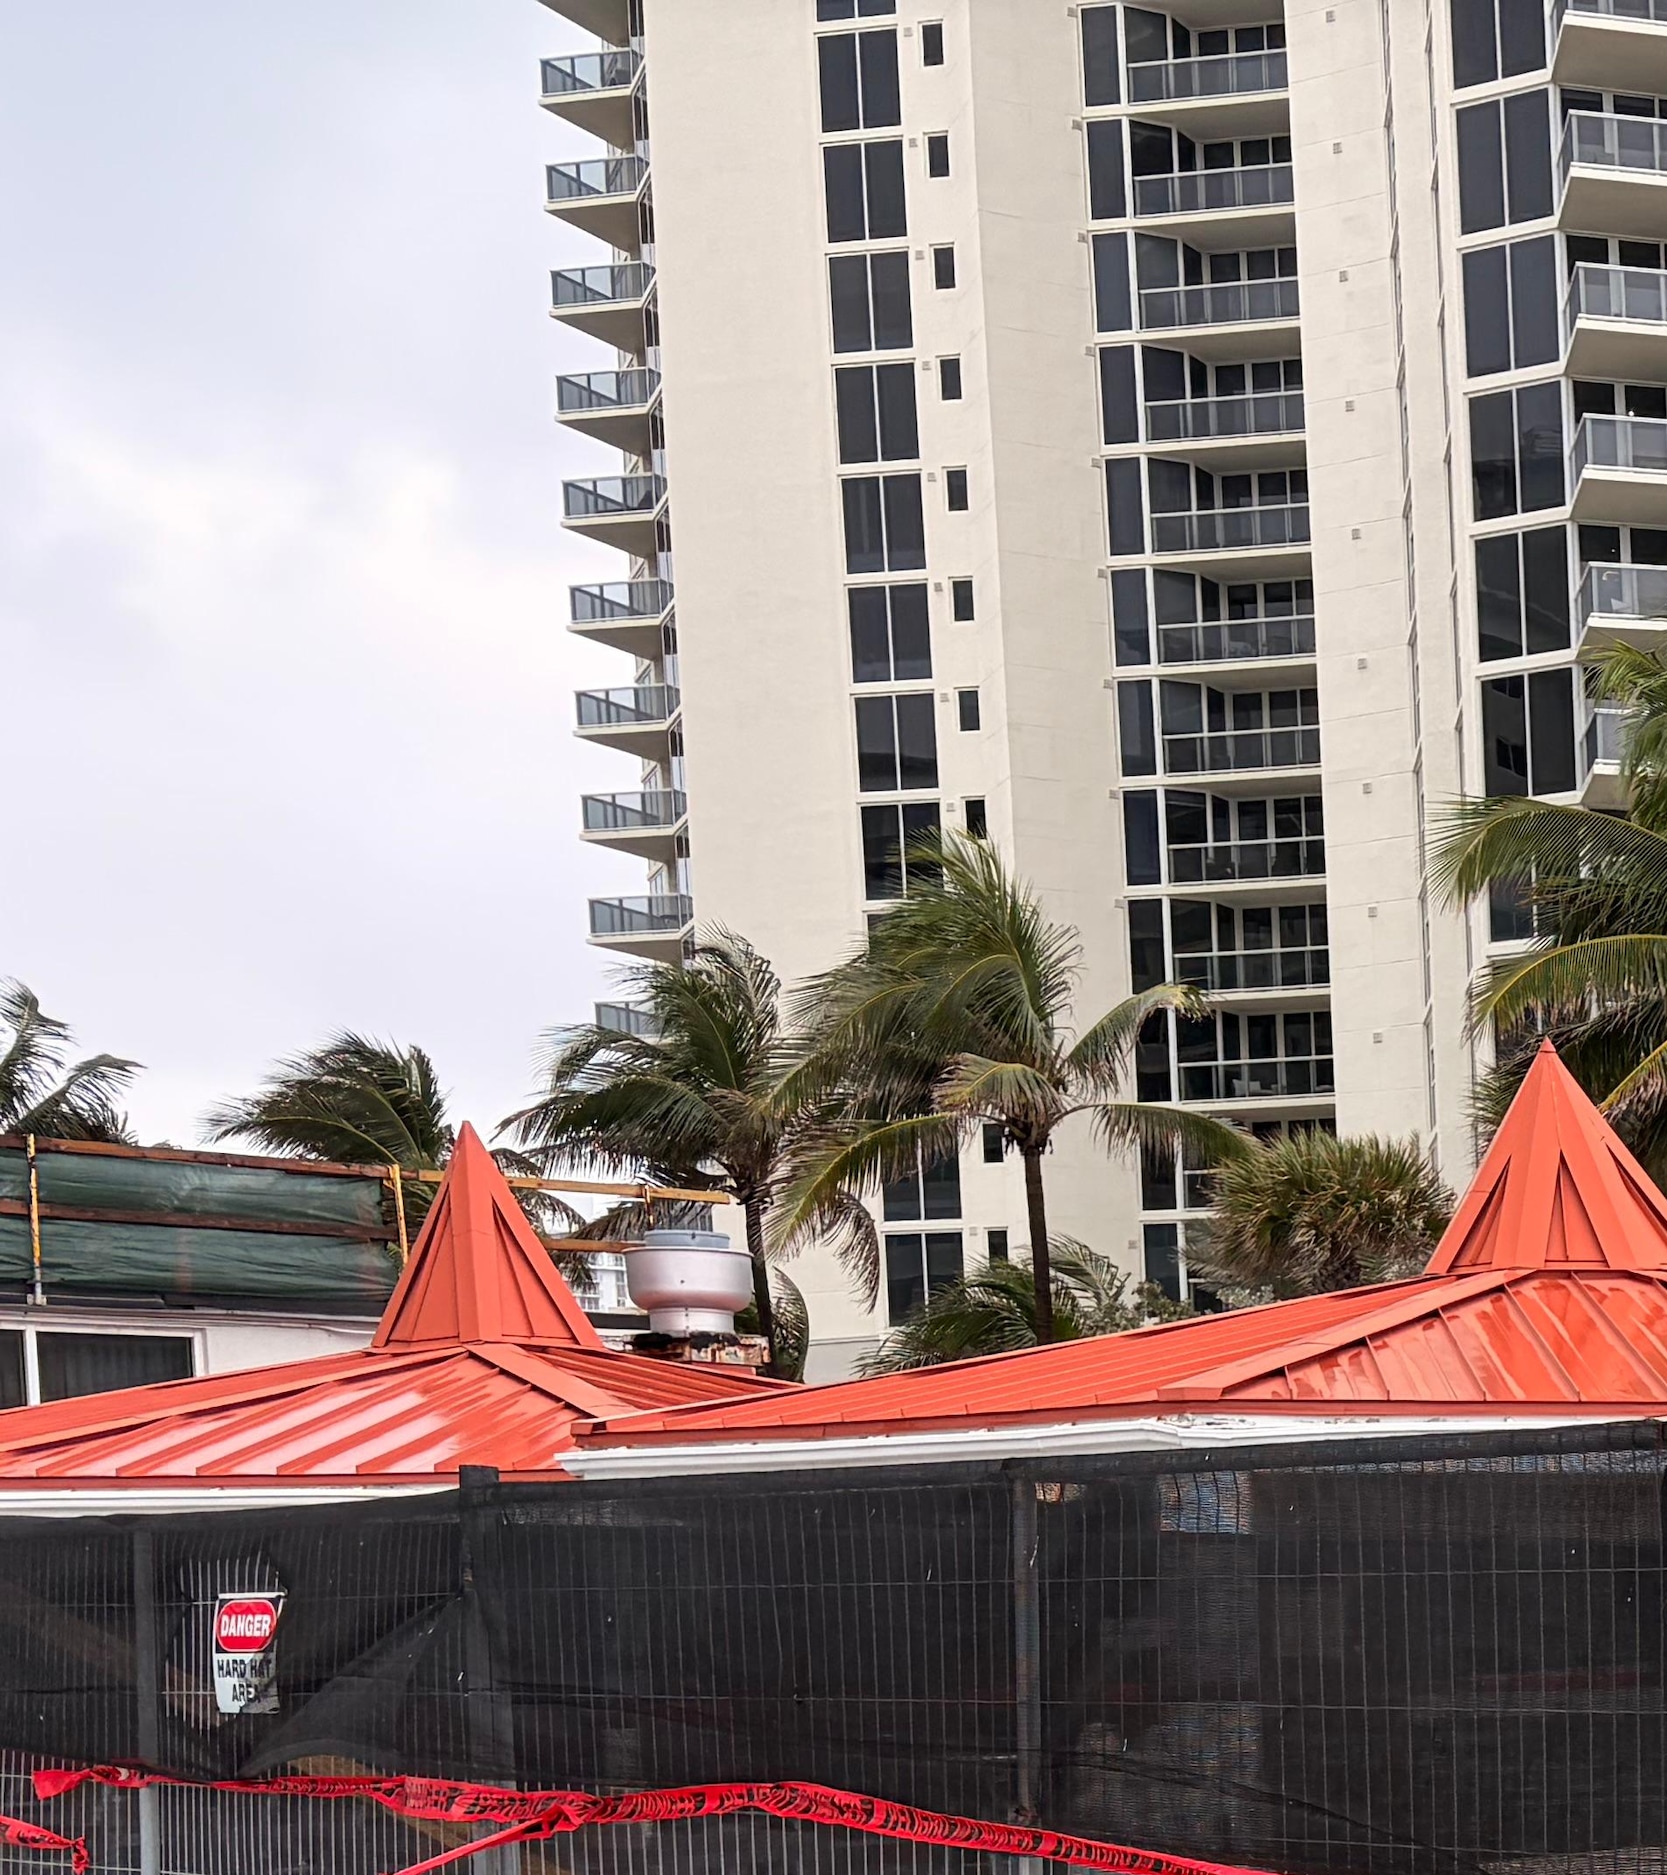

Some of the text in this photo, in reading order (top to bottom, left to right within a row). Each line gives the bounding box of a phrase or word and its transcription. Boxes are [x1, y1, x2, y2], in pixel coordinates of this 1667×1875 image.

[220, 1614, 272, 1638] DANGER
[217, 1658, 272, 1679] HARD HAT
